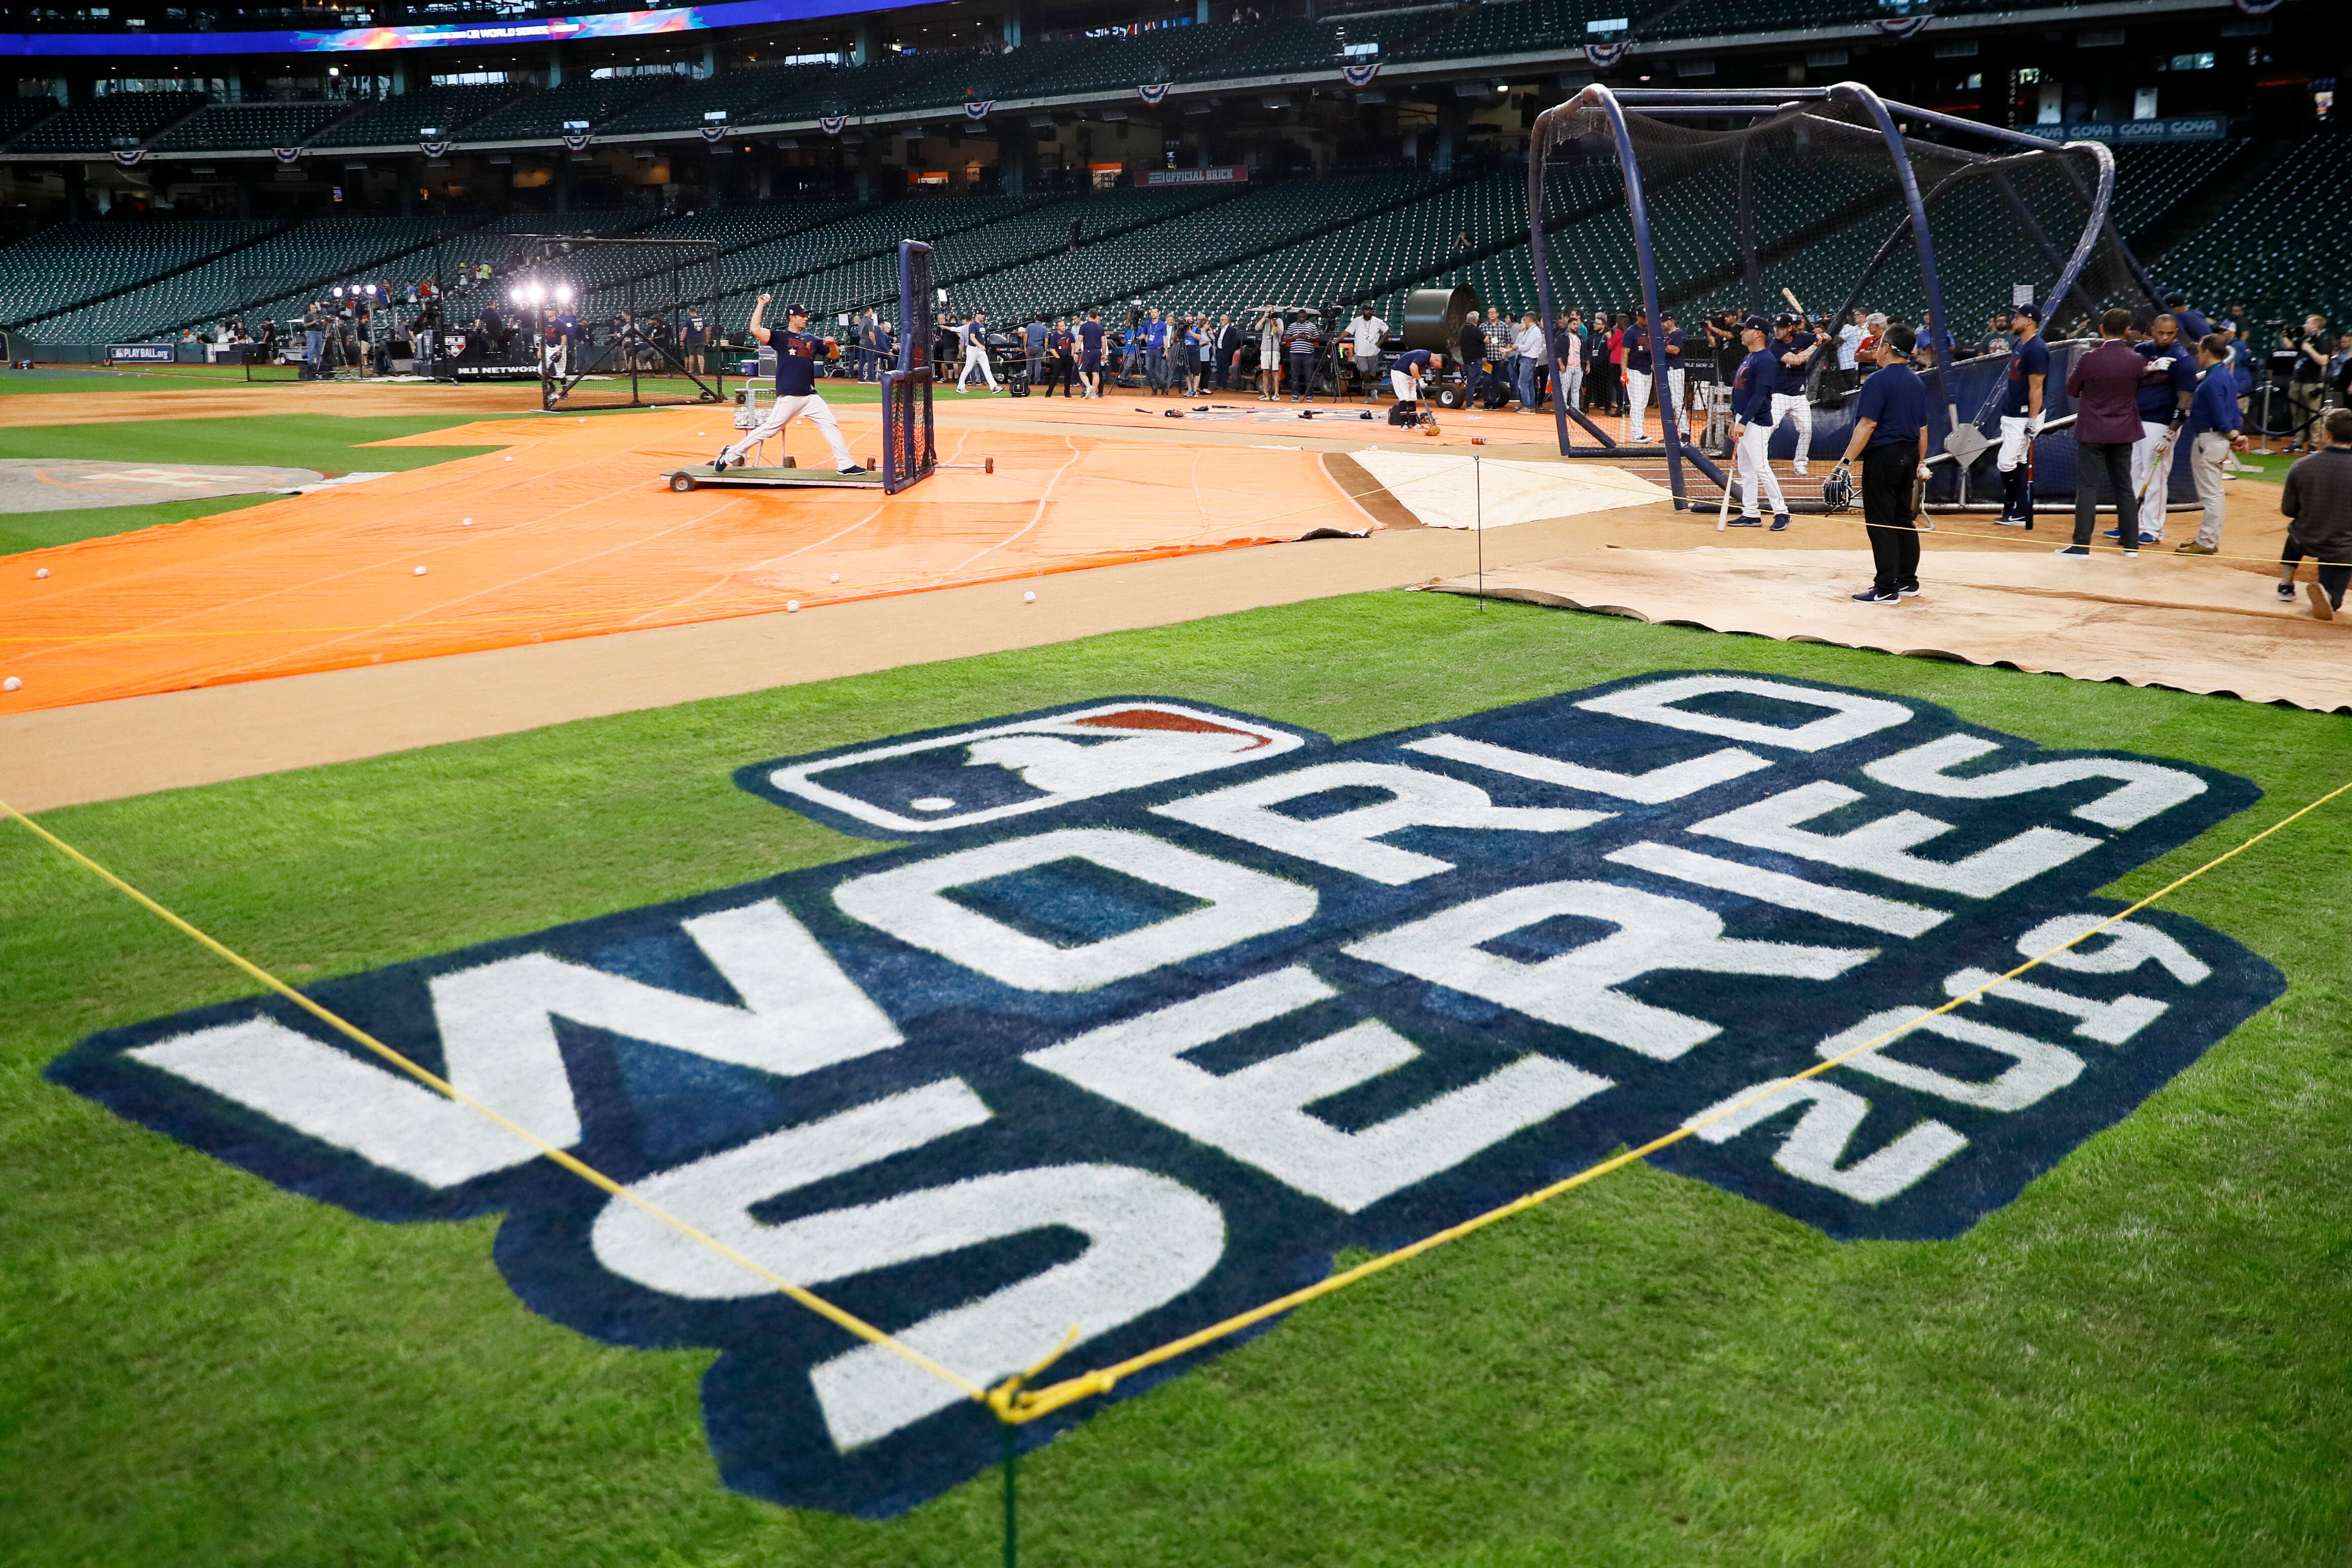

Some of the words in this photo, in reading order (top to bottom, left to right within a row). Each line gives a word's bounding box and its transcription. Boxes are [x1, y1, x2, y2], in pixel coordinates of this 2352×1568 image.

[481, 28, 515, 39] WORLD
[515, 25, 549, 36] SERIES
[2070, 124, 2112, 138] GOYA
[2119, 122, 2164, 136] GOYA
[2170, 120, 2217, 134] GOYA
[1166, 171, 1204, 182] OFFICIAL
[1206, 168, 1233, 180] BRICK
[482, 366, 537, 374] NETWOR
[123, 672, 1914, 1189] WORLD
[1680, 914, 2213, 1204] 2019
[591, 731, 2208, 1451] SERIES
